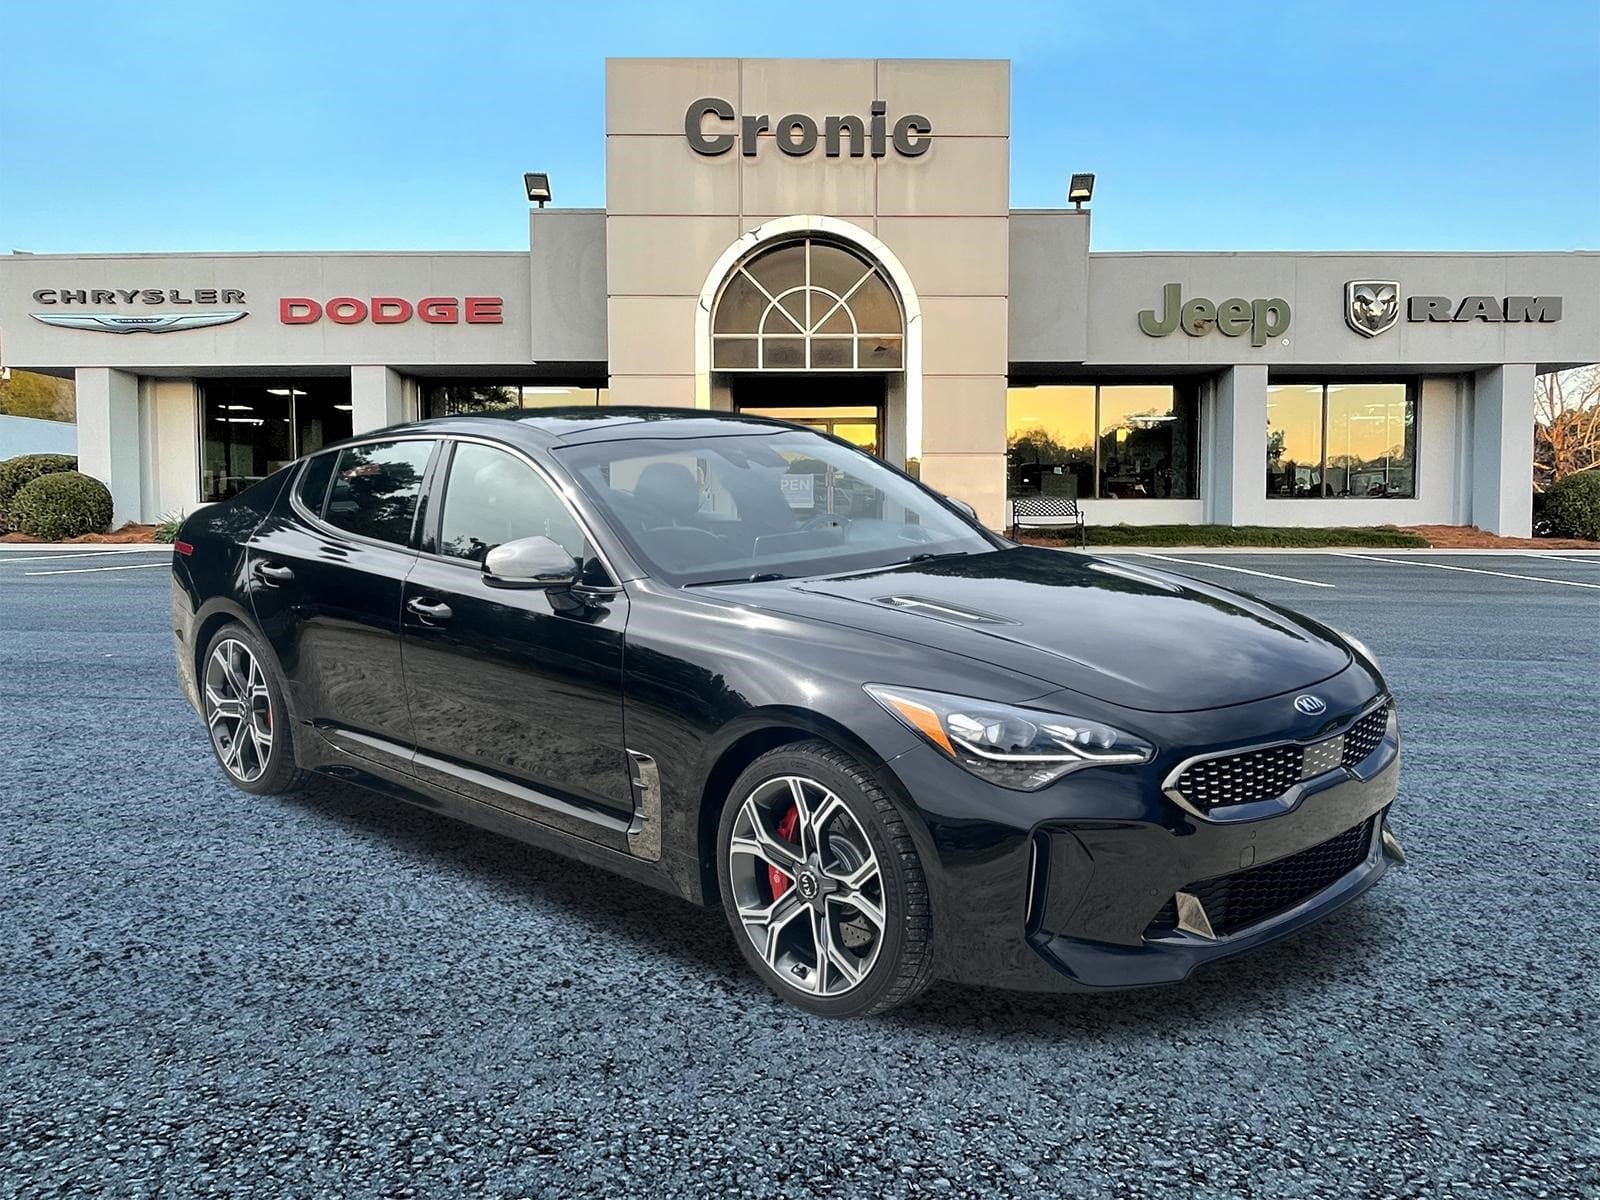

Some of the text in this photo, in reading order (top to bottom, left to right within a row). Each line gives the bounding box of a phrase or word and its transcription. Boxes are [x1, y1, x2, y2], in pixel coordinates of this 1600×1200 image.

[685, 98, 932, 157] Cronic
[32, 289, 247, 304] CHRYSLER
[1407, 296, 1563, 322] RAM
[280, 297, 503, 324] DODGE
[1138, 283, 1291, 347] Jeep
[781, 479, 809, 490] PEN
[1298, 696, 1324, 711] KIA
